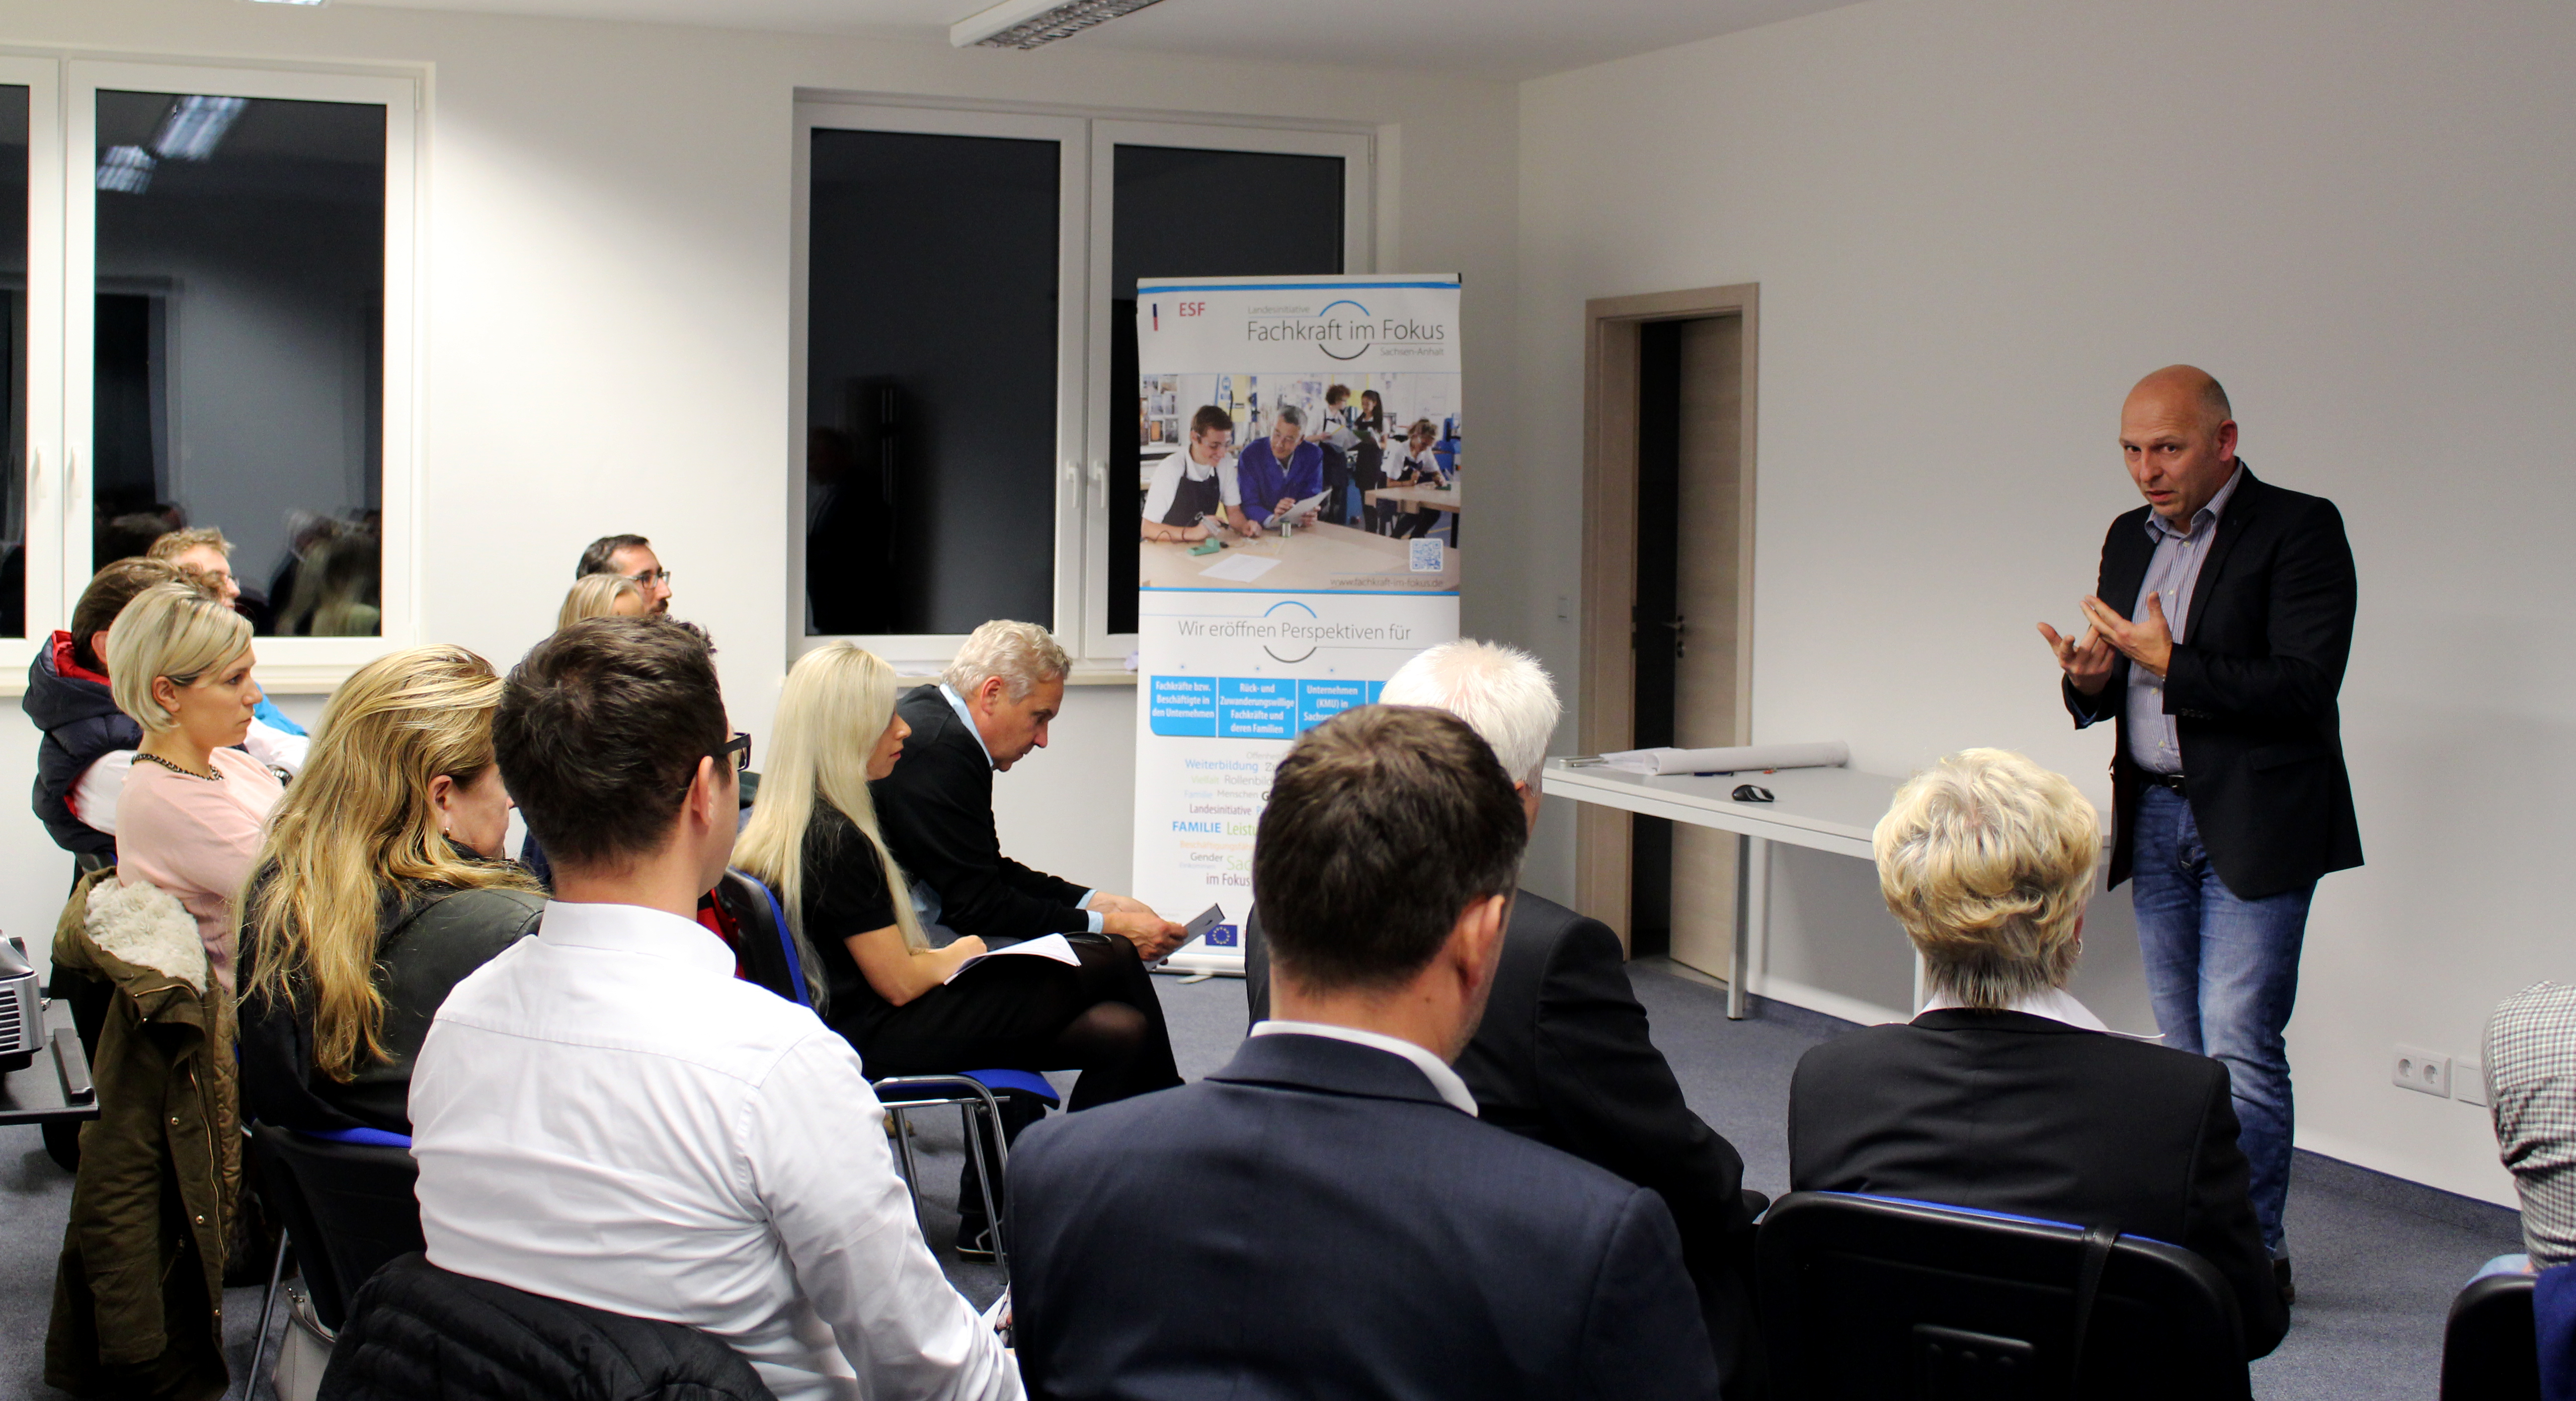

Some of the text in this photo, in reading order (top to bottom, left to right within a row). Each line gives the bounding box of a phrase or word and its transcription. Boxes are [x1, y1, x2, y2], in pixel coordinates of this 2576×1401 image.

[1180, 302, 1206, 316] ESF
[1248, 305, 1310, 314] Landesinitiative
[1247, 319, 1445, 341] Fachkraft im Fokus
[1380, 347, 1444, 356] Sachsen-Anhalt
[1178, 621, 1411, 642] Wir eröffnen Perspektiven für
[1155, 681, 1211, 692] Fachkräfte bzw.
[1239, 683, 1276, 693] Rück- und
[1306, 685, 1359, 695] Unternehmen
[1156, 694, 1210, 706] Beschäftigte in
[1220, 696, 1295, 709] Zuwanderungswillige
[1316, 699, 1340, 709] (KMU)
[1152, 708, 1215, 718] den Unternehmen
[1230, 709, 1285, 720] Fachkräfte und
[1230, 723, 1284, 734] deren Familien
[1185, 759, 1259, 774] Weiterbildung
[1217, 790, 1259, 799] Menschen
[1190, 803, 1252, 815] Landesinitiative
[1172, 821, 1221, 833] FAMILIE
[1190, 852, 1223, 862] Gender
[1207, 873, 1251, 887] im Fokus
